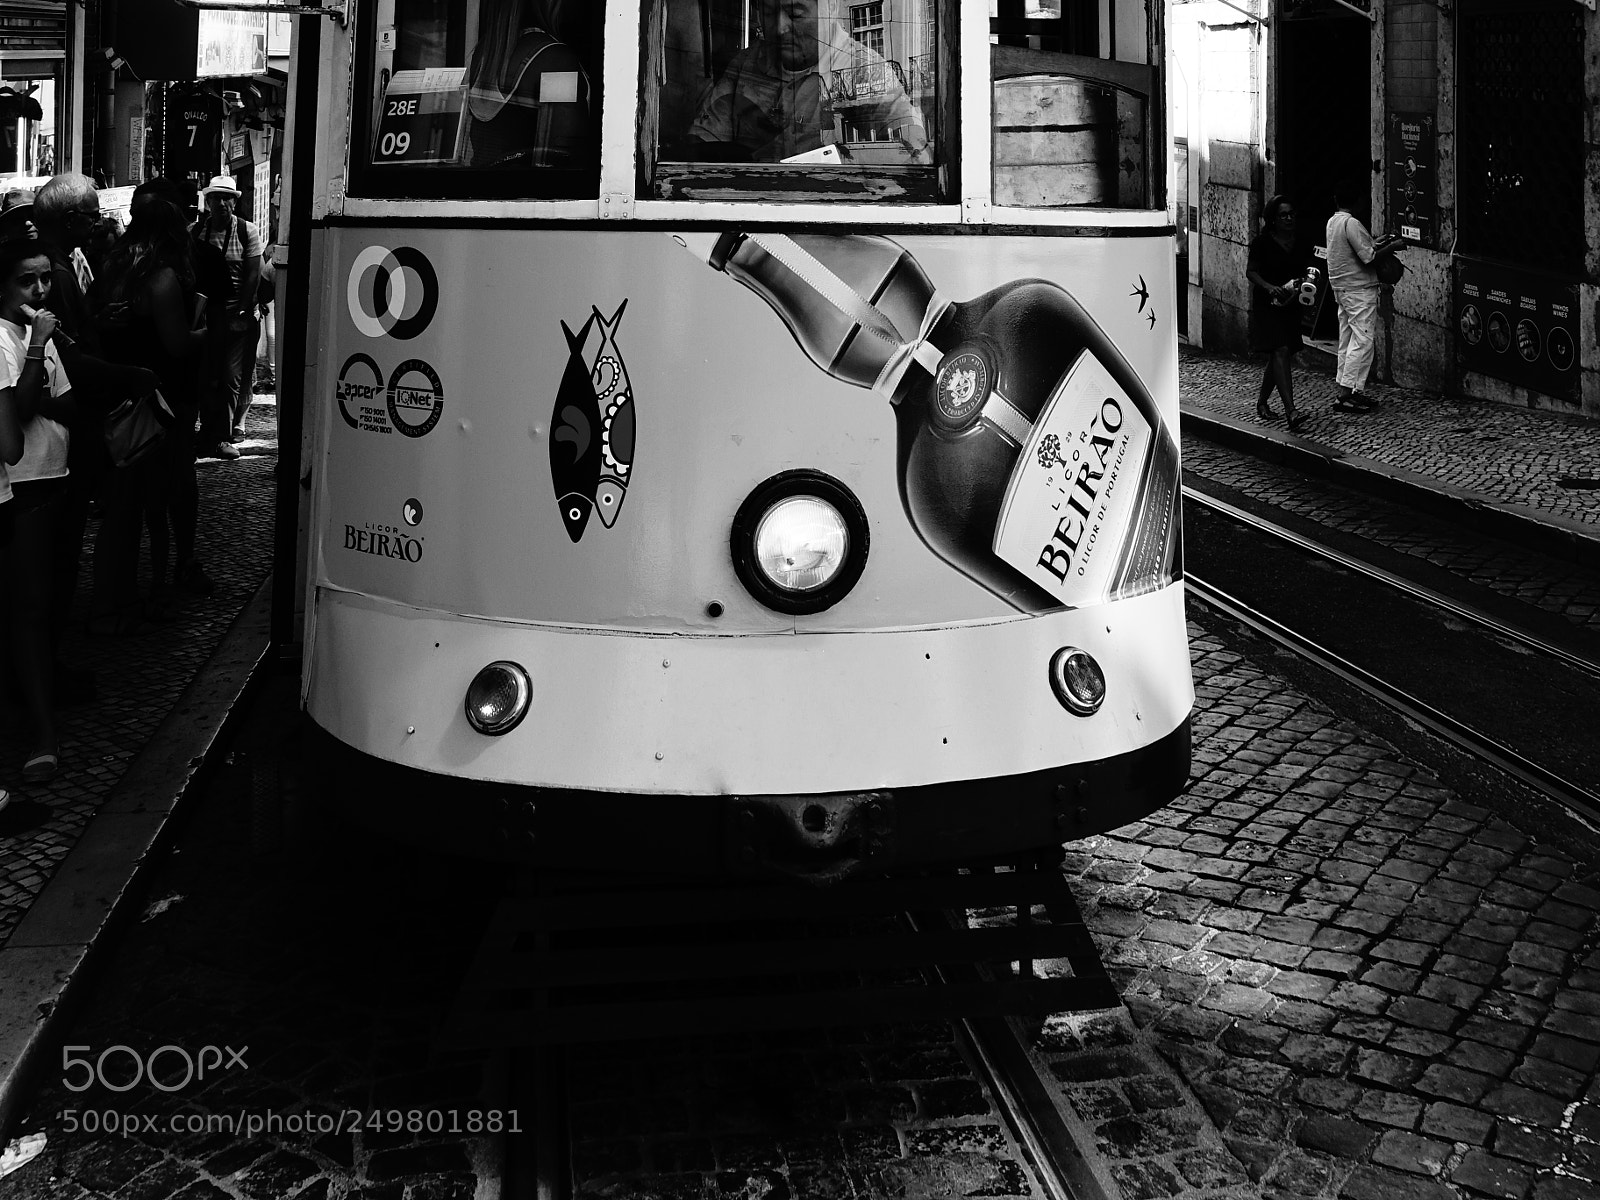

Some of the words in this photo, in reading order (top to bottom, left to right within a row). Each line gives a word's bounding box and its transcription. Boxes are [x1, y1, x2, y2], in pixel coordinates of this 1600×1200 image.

[387, 99, 418, 117] 28E
[187, 125, 198, 148] 7
[381, 131, 411, 156] 09
[344, 382, 376, 402] apcer
[396, 389, 432, 407] IQNet
[1051, 430, 1088, 512] LICOR
[1036, 397, 1123, 587] BEIRÃO
[1077, 566, 1085, 577] O
[1081, 525, 1100, 565] LICOR
[1097, 502, 1108, 522] DE
[1104, 434, 1130, 500] PORTUGAL
[365, 522, 399, 534] LICOR
[343, 524, 423, 563] BEIRÃO
